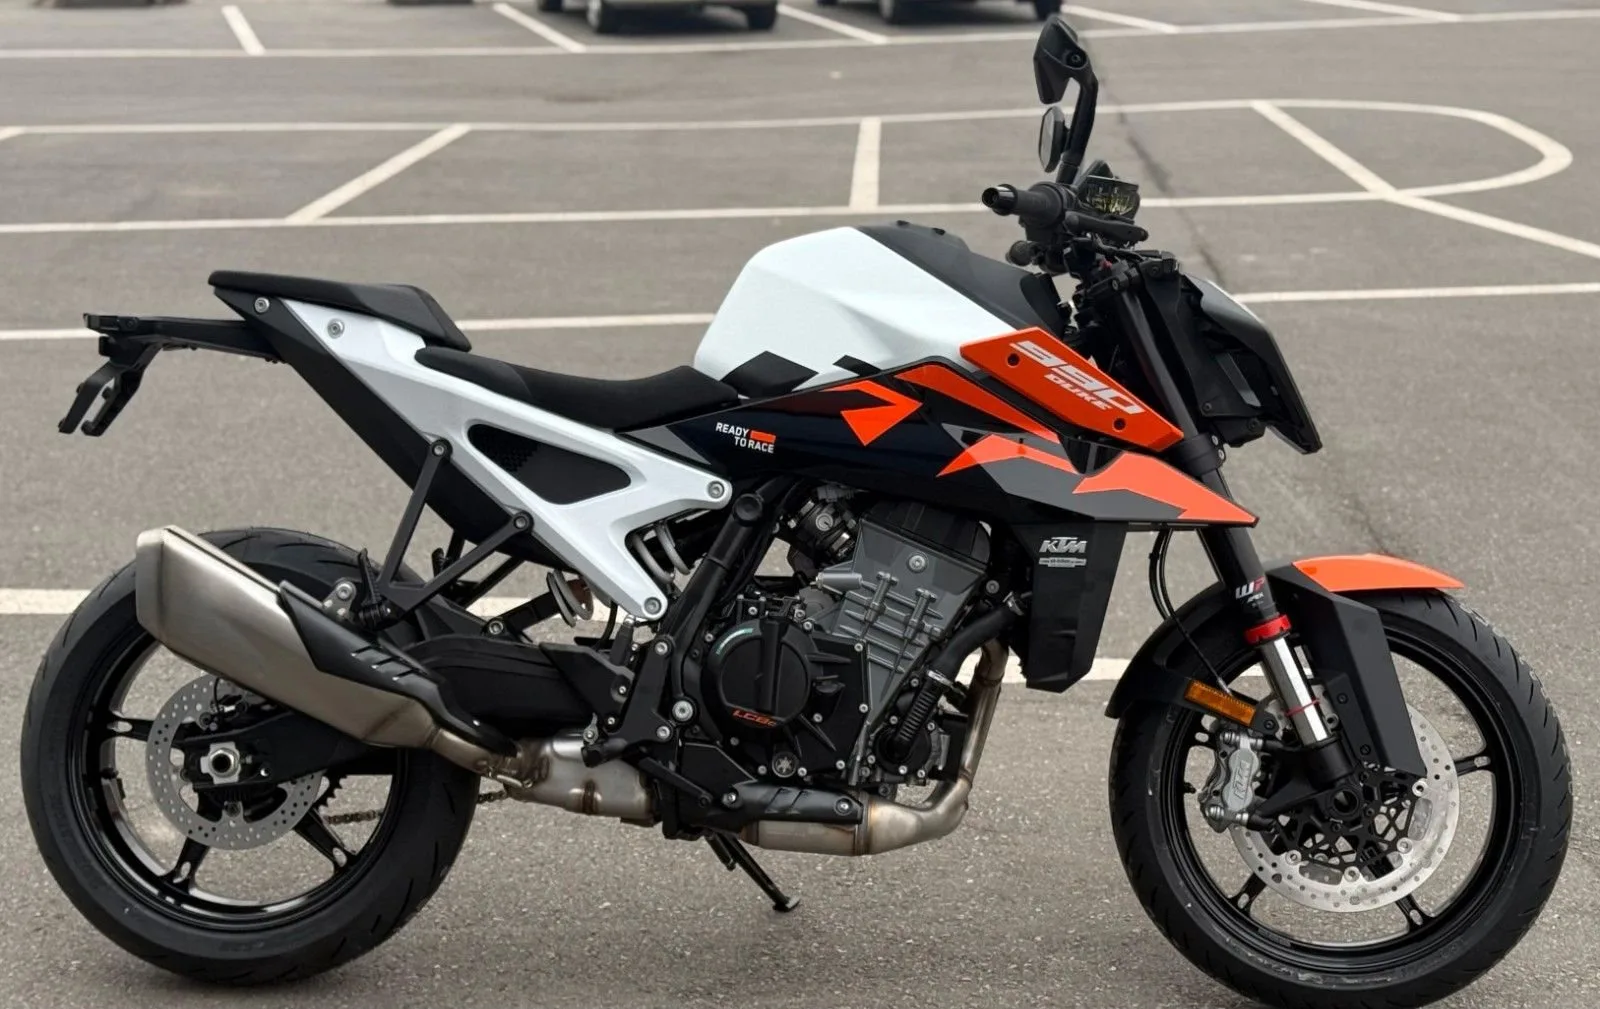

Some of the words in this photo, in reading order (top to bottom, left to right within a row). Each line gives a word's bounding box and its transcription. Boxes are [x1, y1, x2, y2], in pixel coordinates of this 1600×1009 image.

[1044, 373, 1112, 410] DUKE
[715, 422, 749, 437] READY
[734, 436, 747, 447] TO
[747, 440, 774, 453] RACE
[1039, 536, 1087, 553] KTM
[1235, 576, 1265, 599] WP
